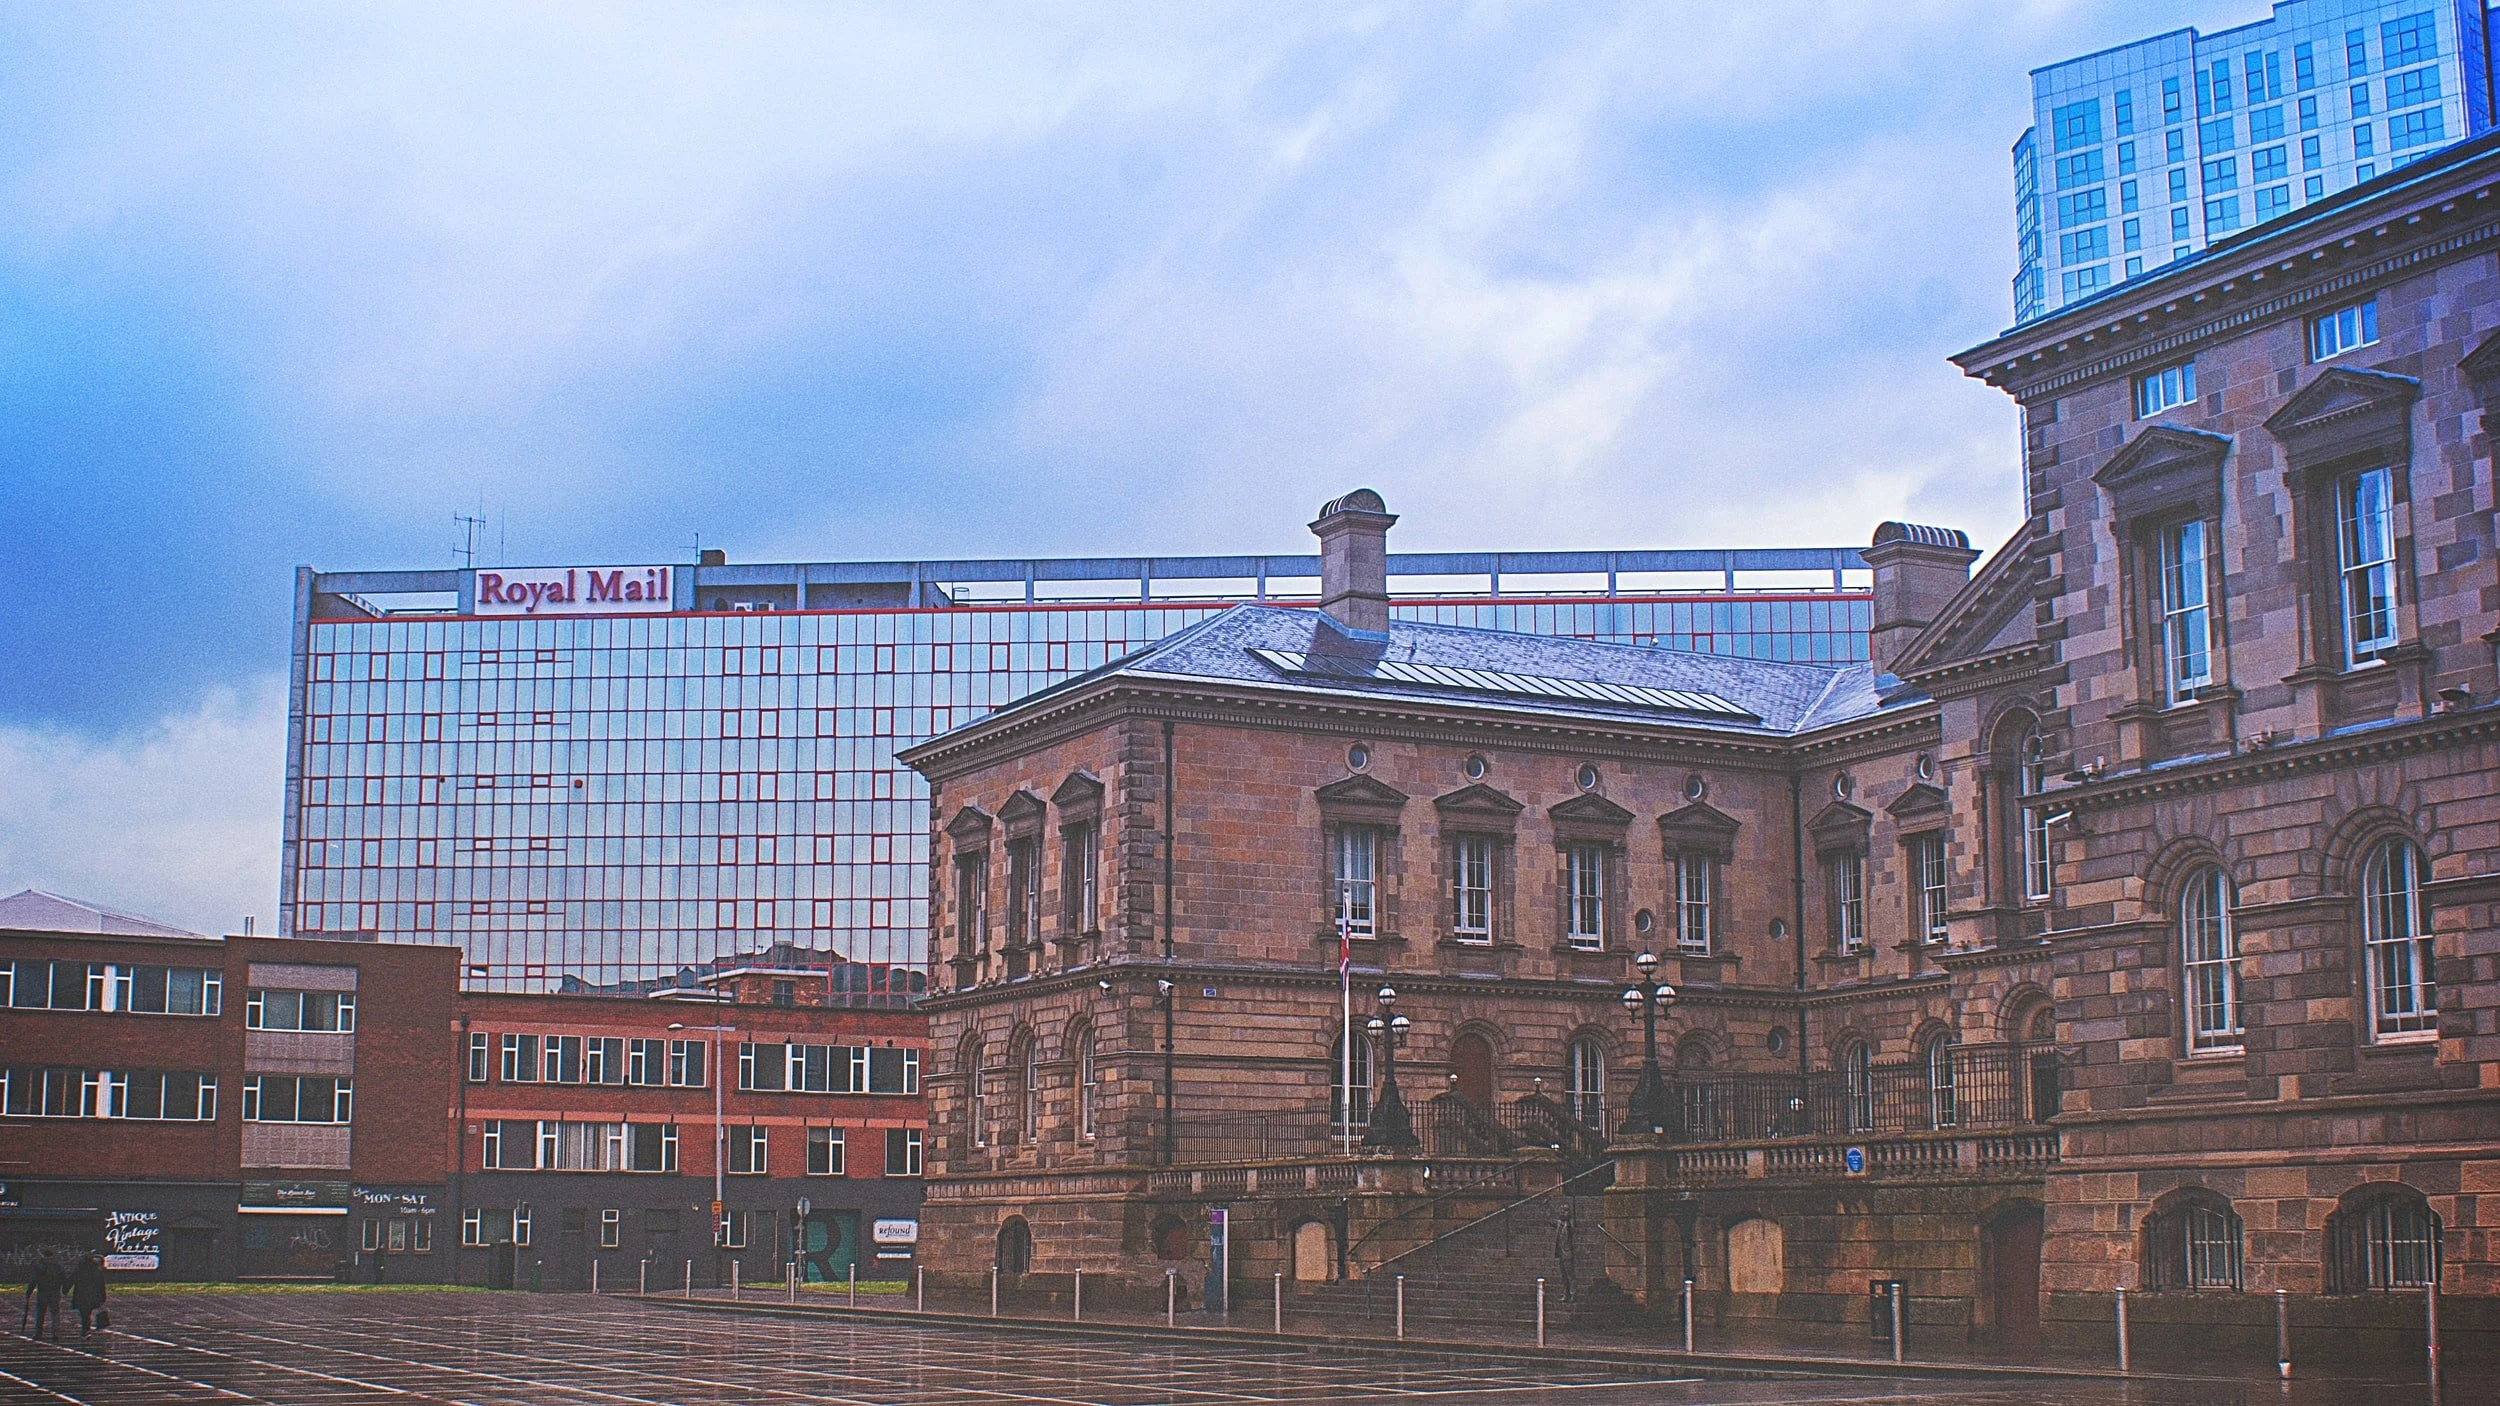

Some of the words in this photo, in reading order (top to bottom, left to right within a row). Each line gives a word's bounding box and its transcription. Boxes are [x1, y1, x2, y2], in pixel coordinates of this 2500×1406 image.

[478, 569, 576, 612] Royal
[586, 567, 669, 601] Mail
[363, 1193, 393, 1204] MON
[401, 1194, 427, 1205] SAT
[105, 1224, 160, 1248] Vintage
[116, 1241, 160, 1253] Retro
